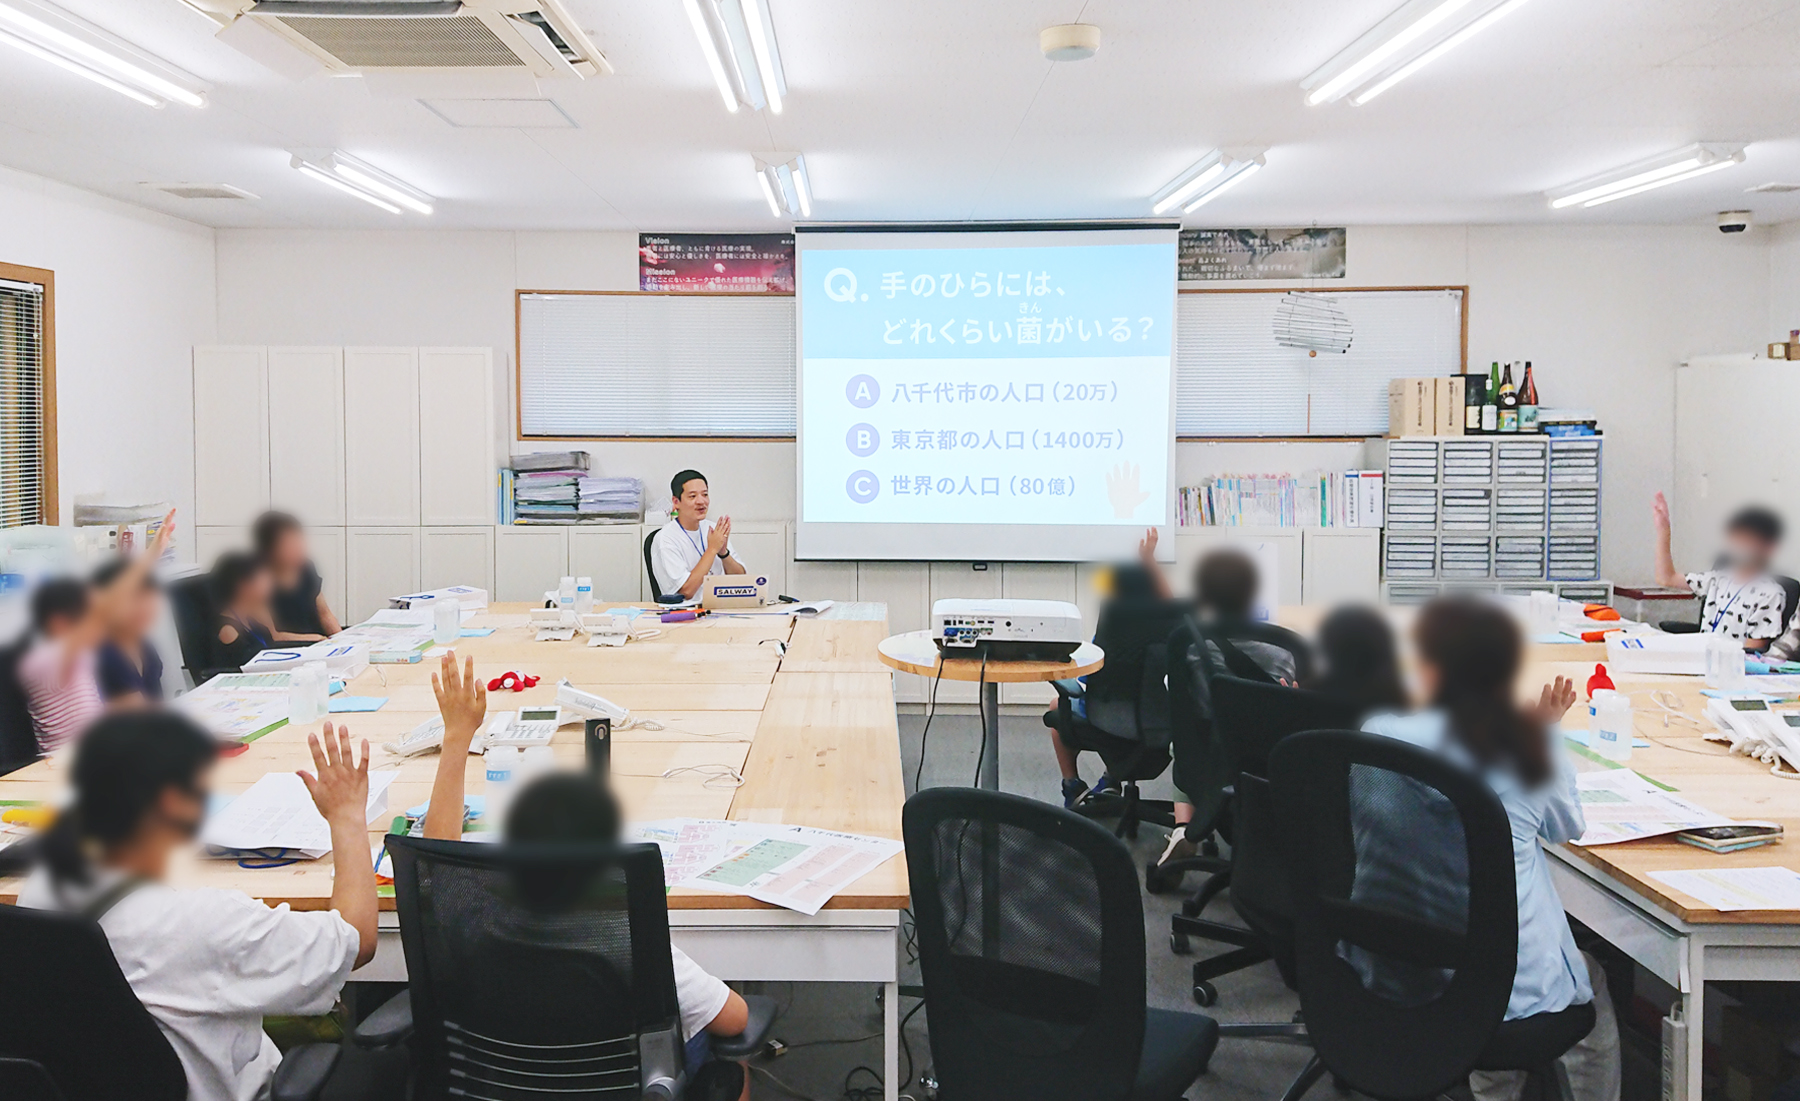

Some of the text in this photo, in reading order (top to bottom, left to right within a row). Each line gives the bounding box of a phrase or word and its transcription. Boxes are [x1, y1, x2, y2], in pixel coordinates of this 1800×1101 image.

[645, 236, 670, 245] Vision
[824, 268, 868, 303] Q.
[880, 271, 1065, 299] 手のひらには、
[1019, 302, 1042, 314] きん
[883, 315, 1154, 345] どれくらい菌がいる？
[855, 382, 871, 400] A
[857, 431, 871, 448] B
[854, 476, 872, 496] C
